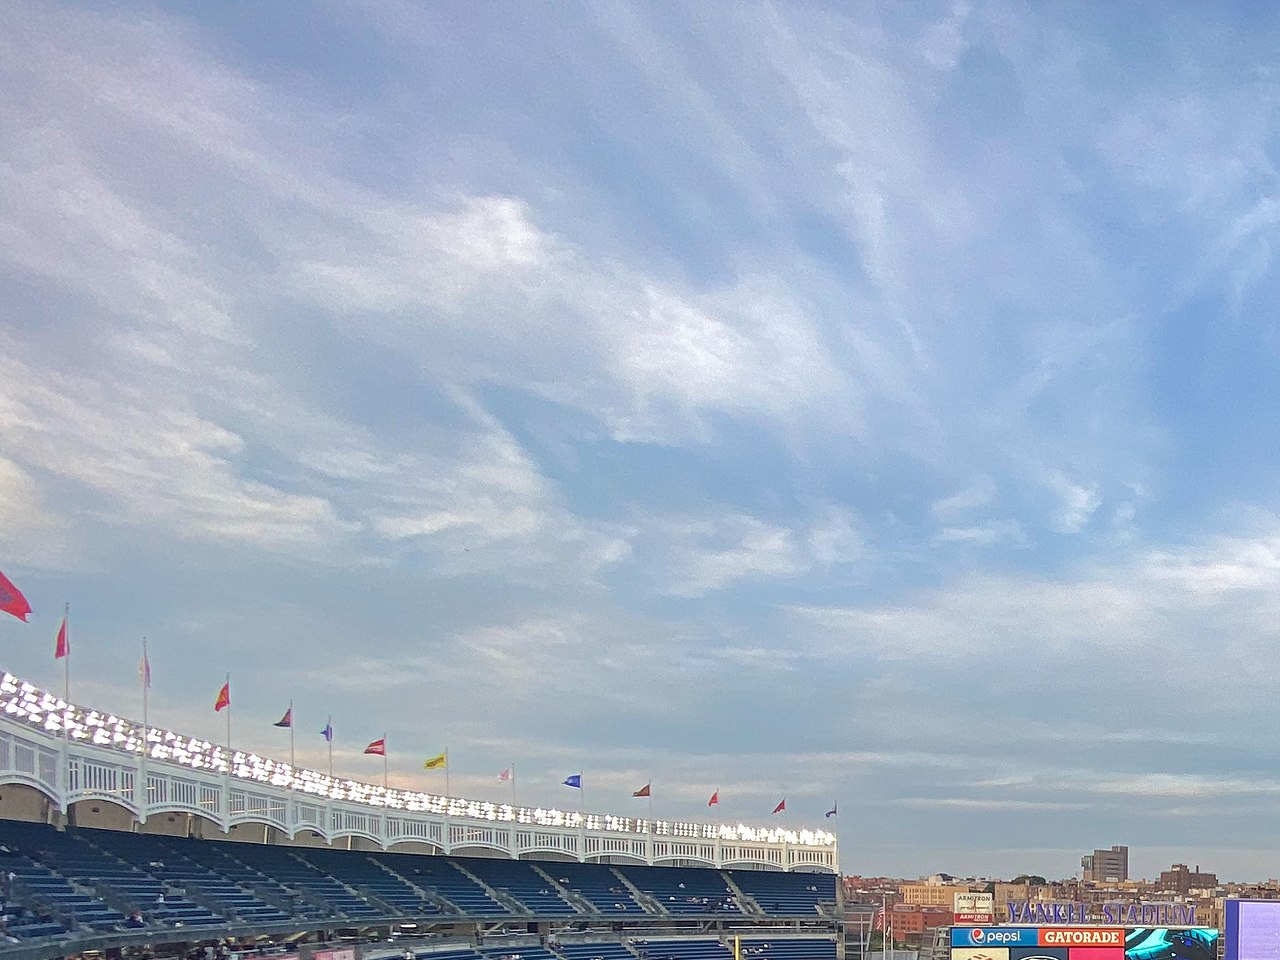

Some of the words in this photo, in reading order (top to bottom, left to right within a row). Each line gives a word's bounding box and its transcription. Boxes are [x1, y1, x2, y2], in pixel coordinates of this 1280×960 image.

[1102, 902, 1198, 926] STADIUM
[987, 930, 1021, 943] pepsi
[1044, 931, 1119, 943] GATORADE
